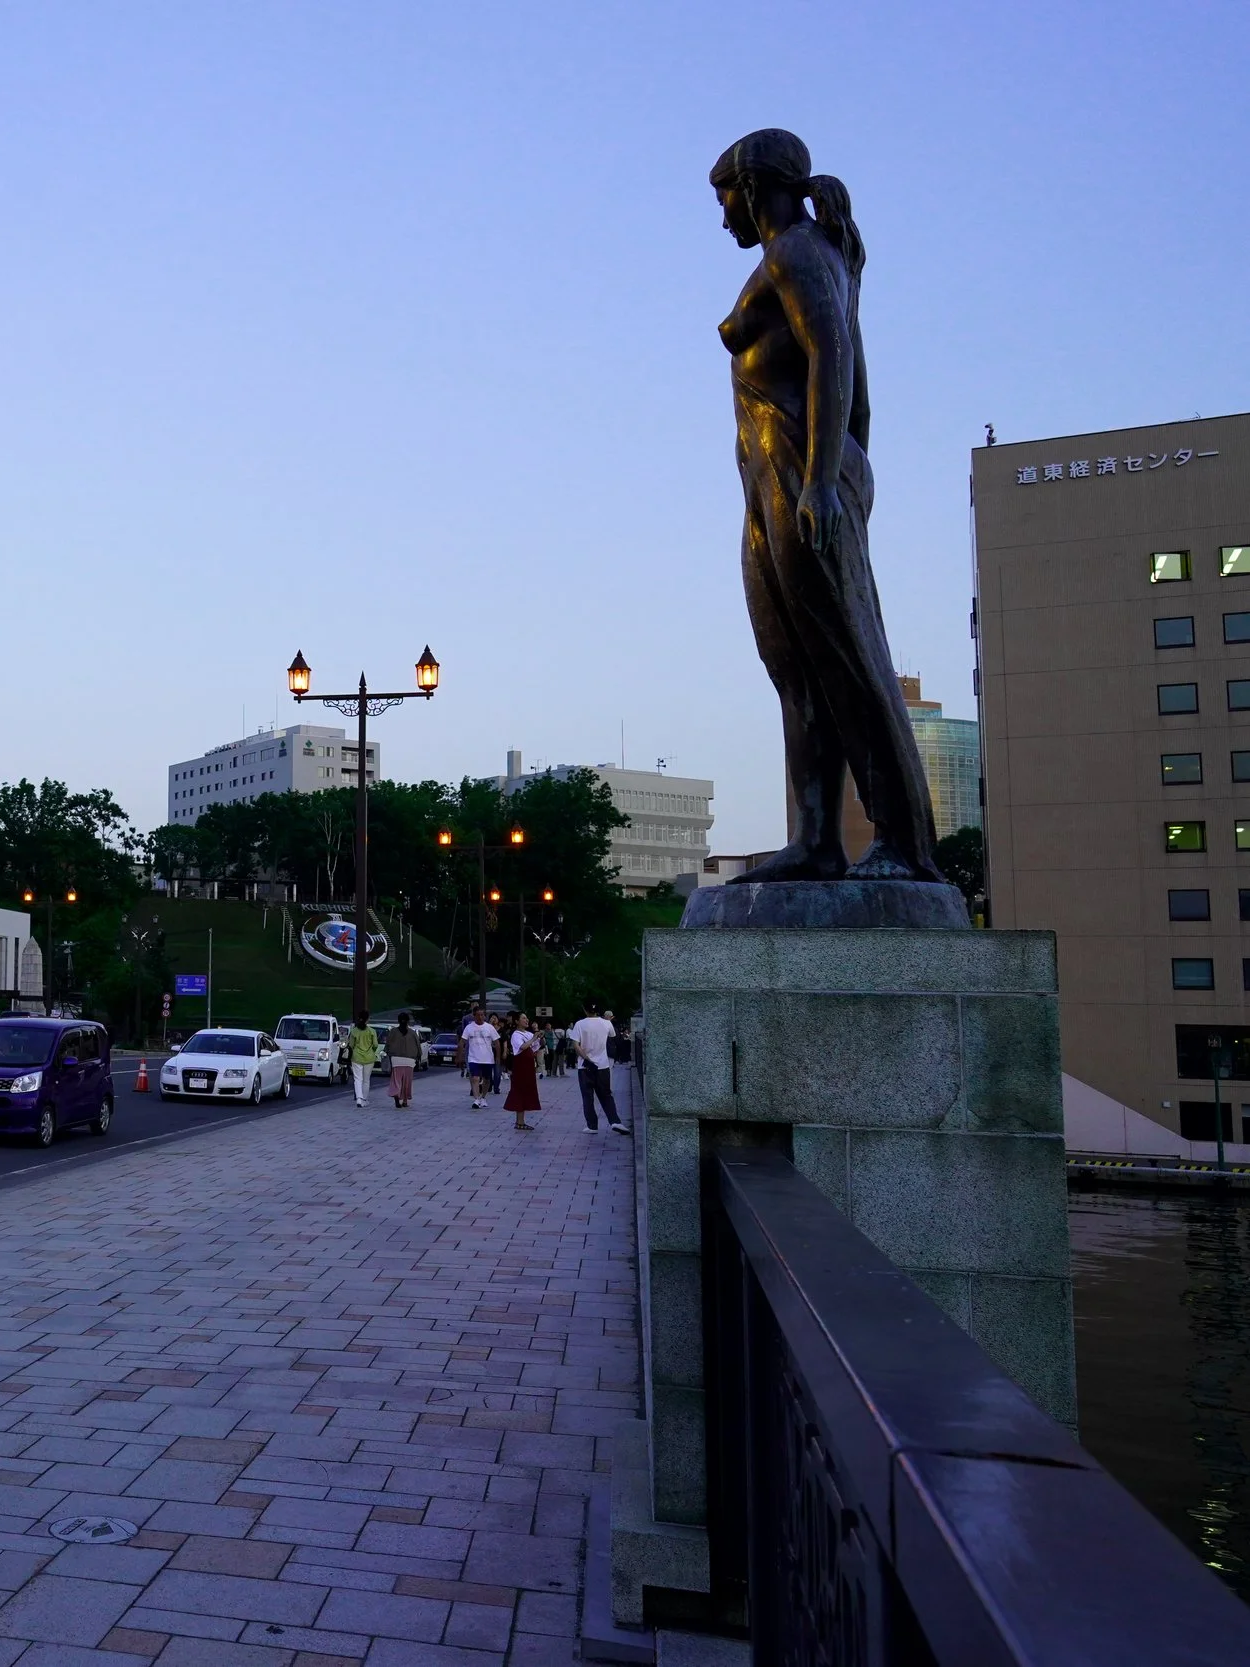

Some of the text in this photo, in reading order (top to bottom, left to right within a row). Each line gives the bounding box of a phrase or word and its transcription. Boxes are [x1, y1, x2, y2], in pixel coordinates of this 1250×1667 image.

[1016, 448, 1220, 485] 道東経済センター
